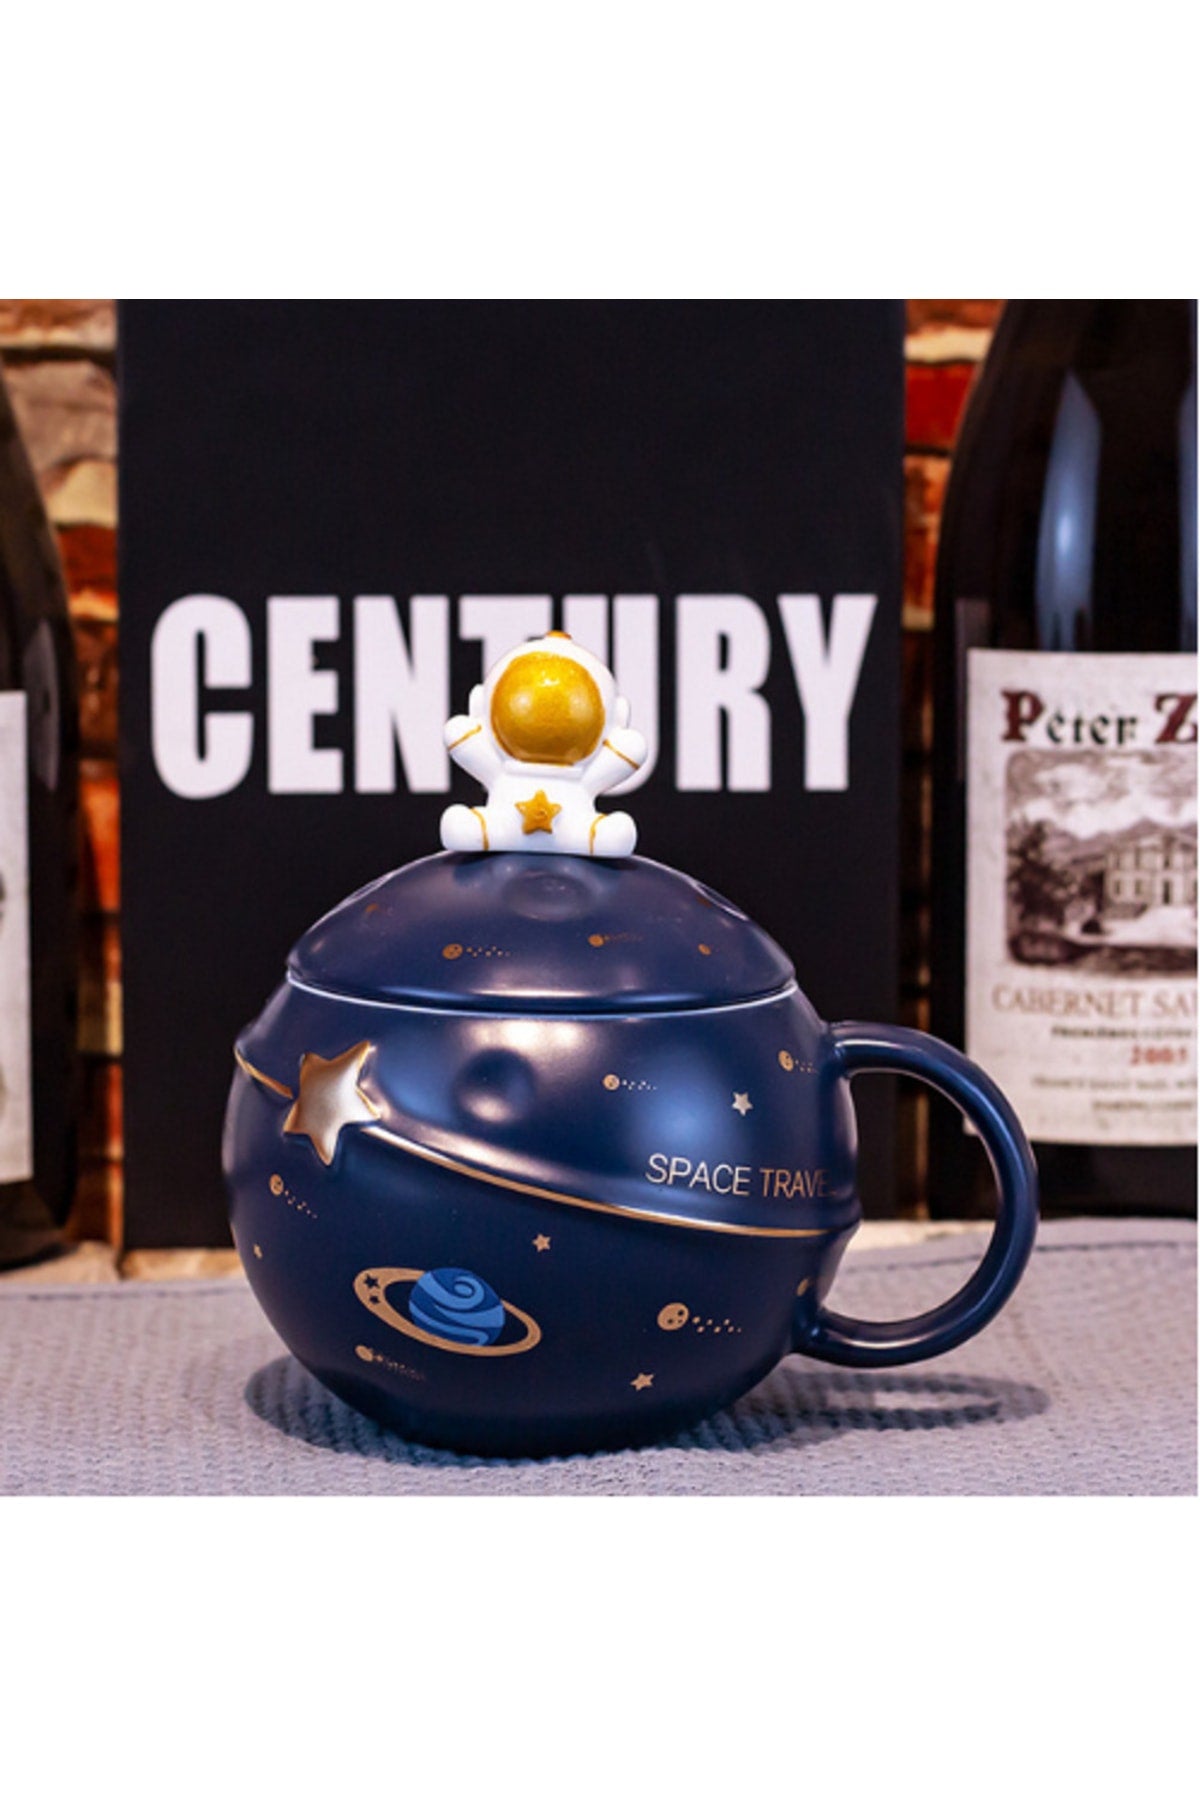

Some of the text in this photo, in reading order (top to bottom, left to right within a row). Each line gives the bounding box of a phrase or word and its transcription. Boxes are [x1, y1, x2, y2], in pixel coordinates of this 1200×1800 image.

[991, 984, 1198, 1018] CABERNET SA
[645, 1152, 836, 1199] SPACE TRAVE
